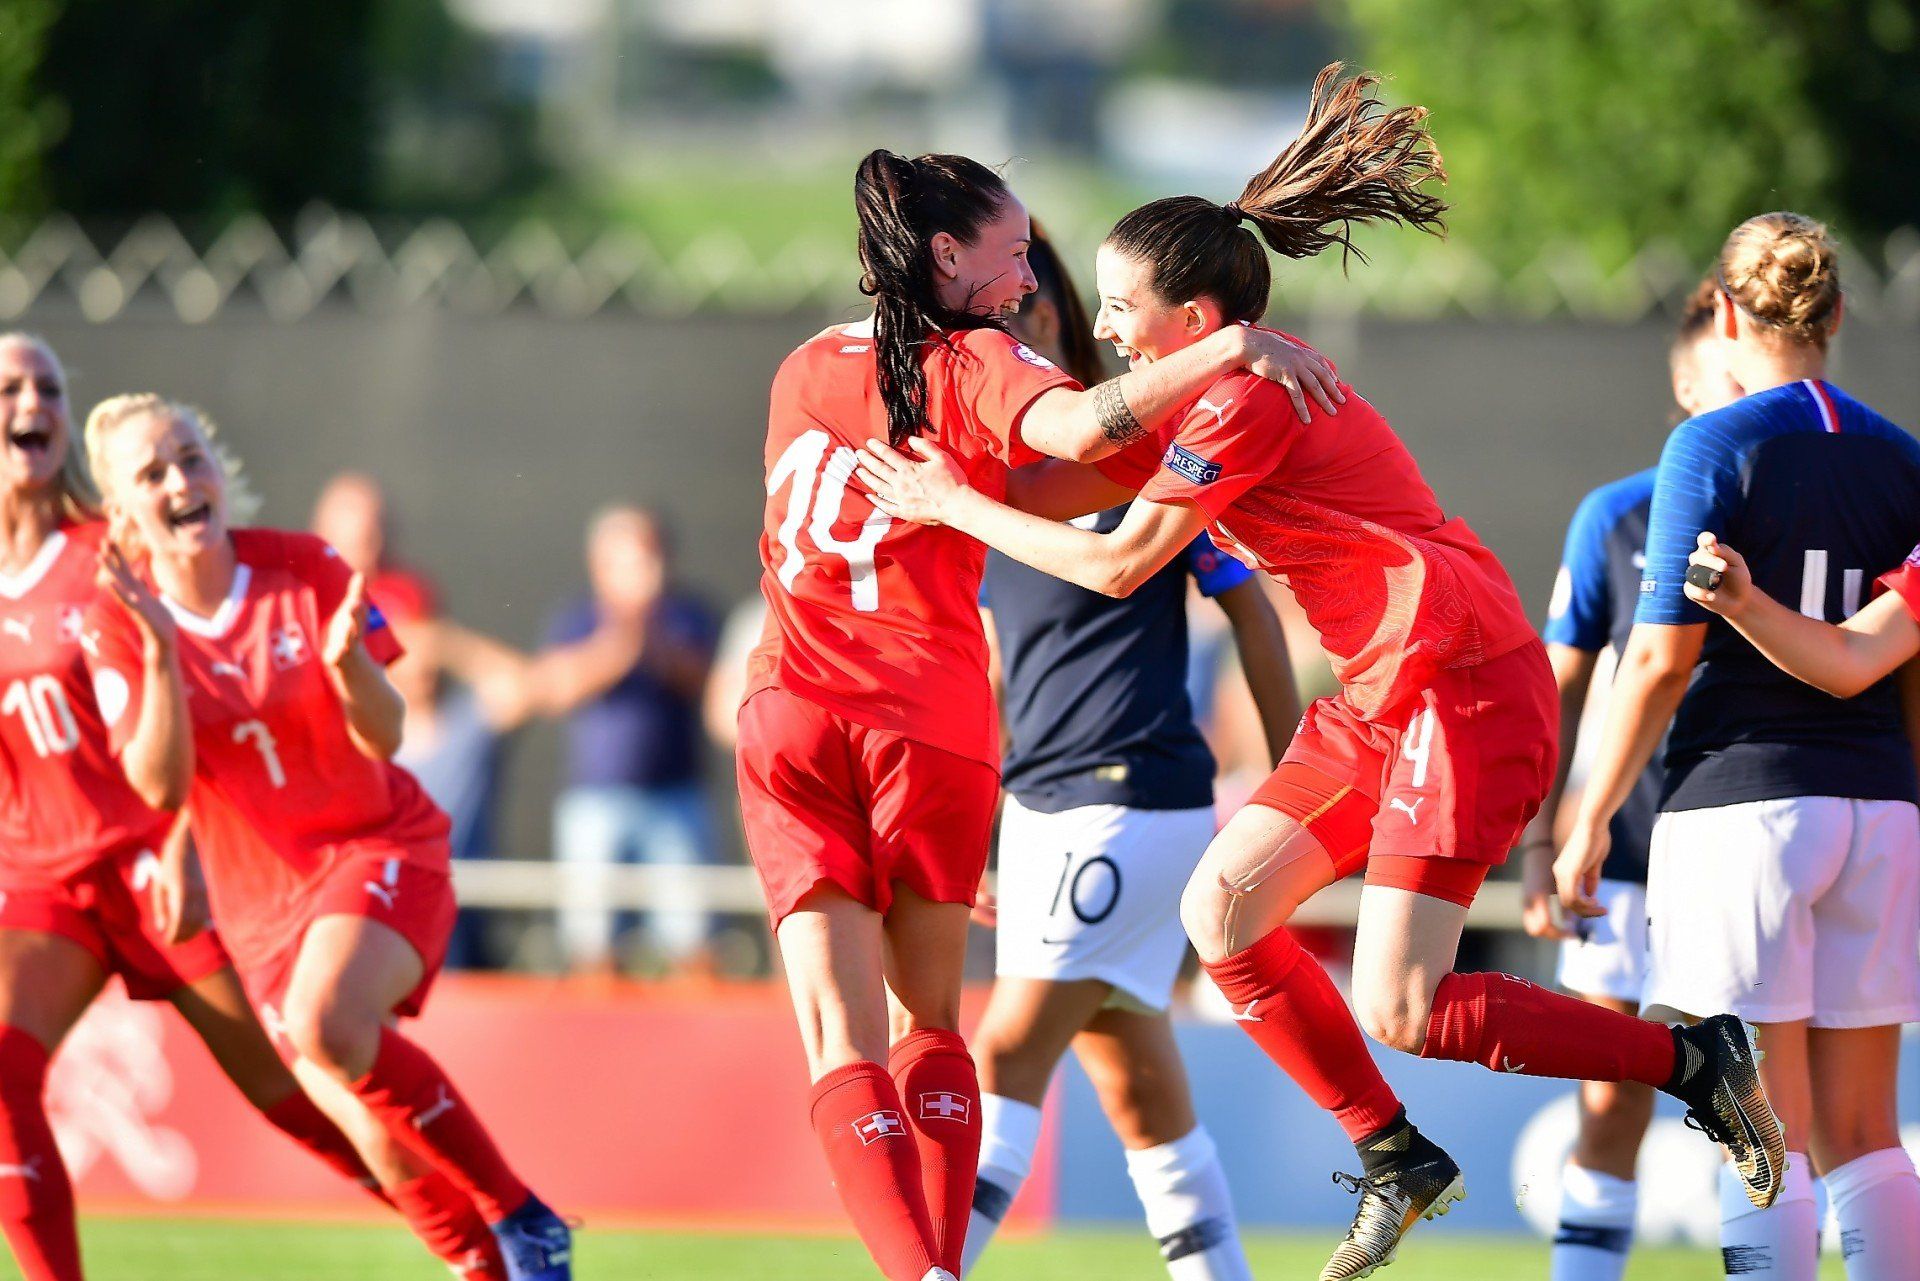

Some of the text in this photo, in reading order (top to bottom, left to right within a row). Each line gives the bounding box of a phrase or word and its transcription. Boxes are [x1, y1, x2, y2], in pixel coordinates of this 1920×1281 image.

[1173, 453, 1219, 481] RESPECT
[767, 429, 892, 612] 14
[1, 674, 80, 757] 10
[232, 719, 286, 788] 7
[1403, 706, 1435, 788] 4
[1049, 851, 1122, 924] 10
